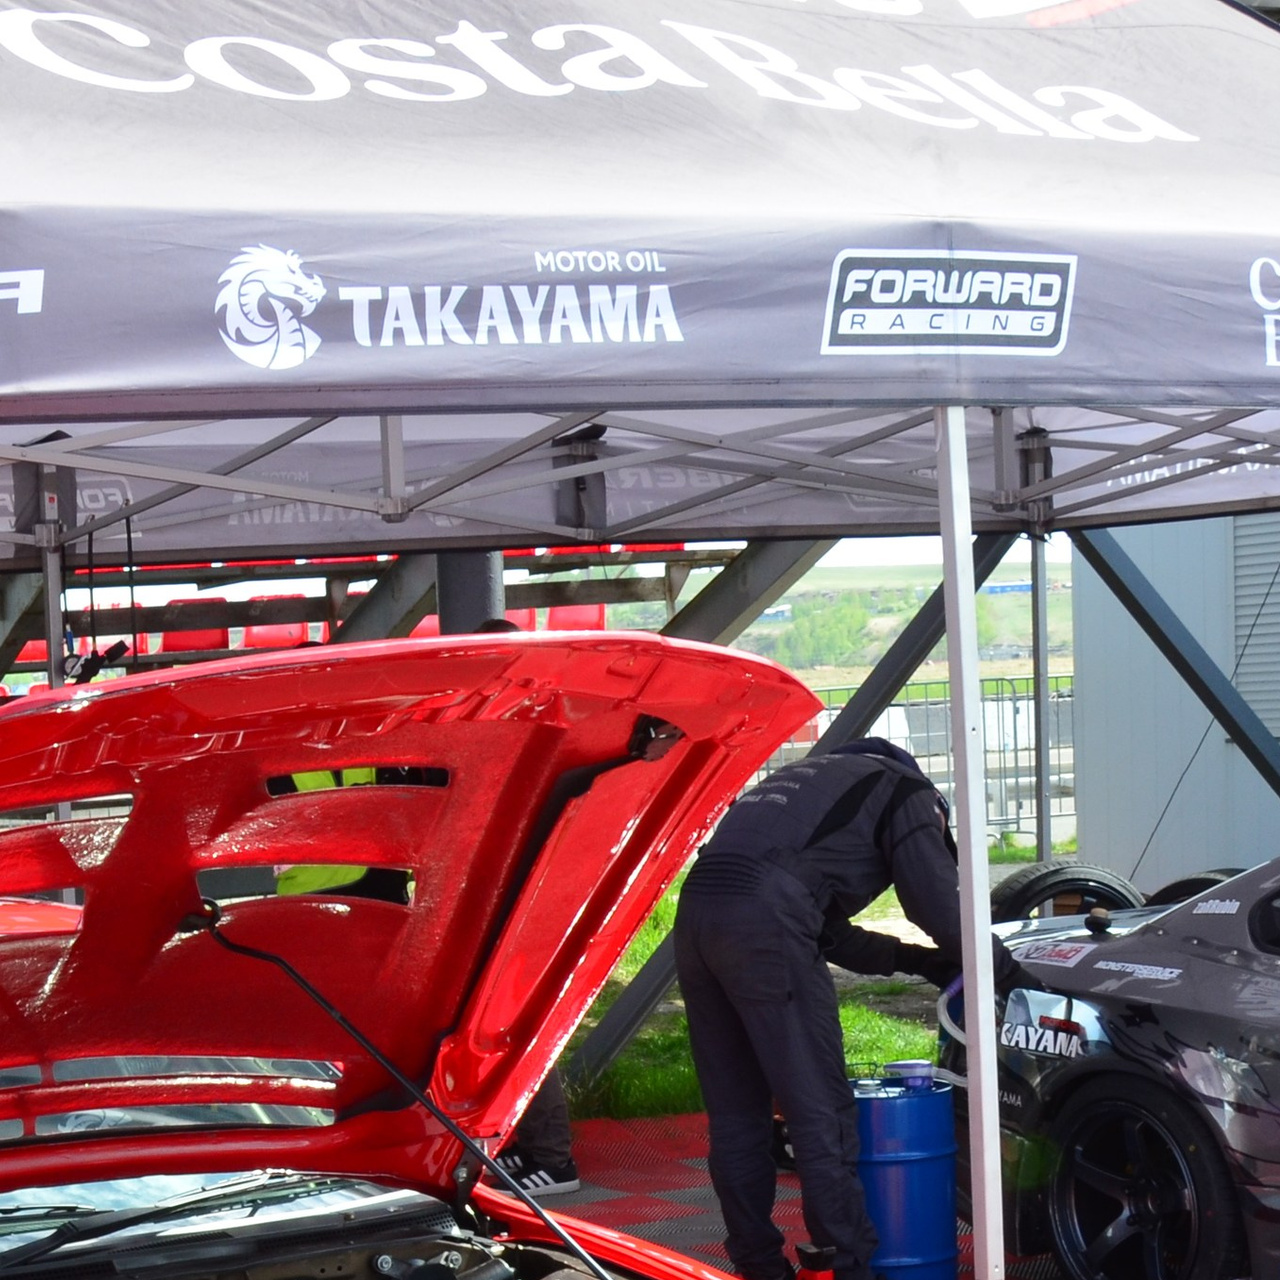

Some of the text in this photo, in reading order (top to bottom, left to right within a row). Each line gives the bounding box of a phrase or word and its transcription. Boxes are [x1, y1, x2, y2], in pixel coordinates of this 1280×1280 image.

[659, 20, 1200, 142] Bella
[534, 251, 666, 272] MOTOR OIL
[842, 269, 1062, 306] FORWARD
[339, 284, 684, 347] TAKAYAMA
[850, 313, 1046, 331] RACING
